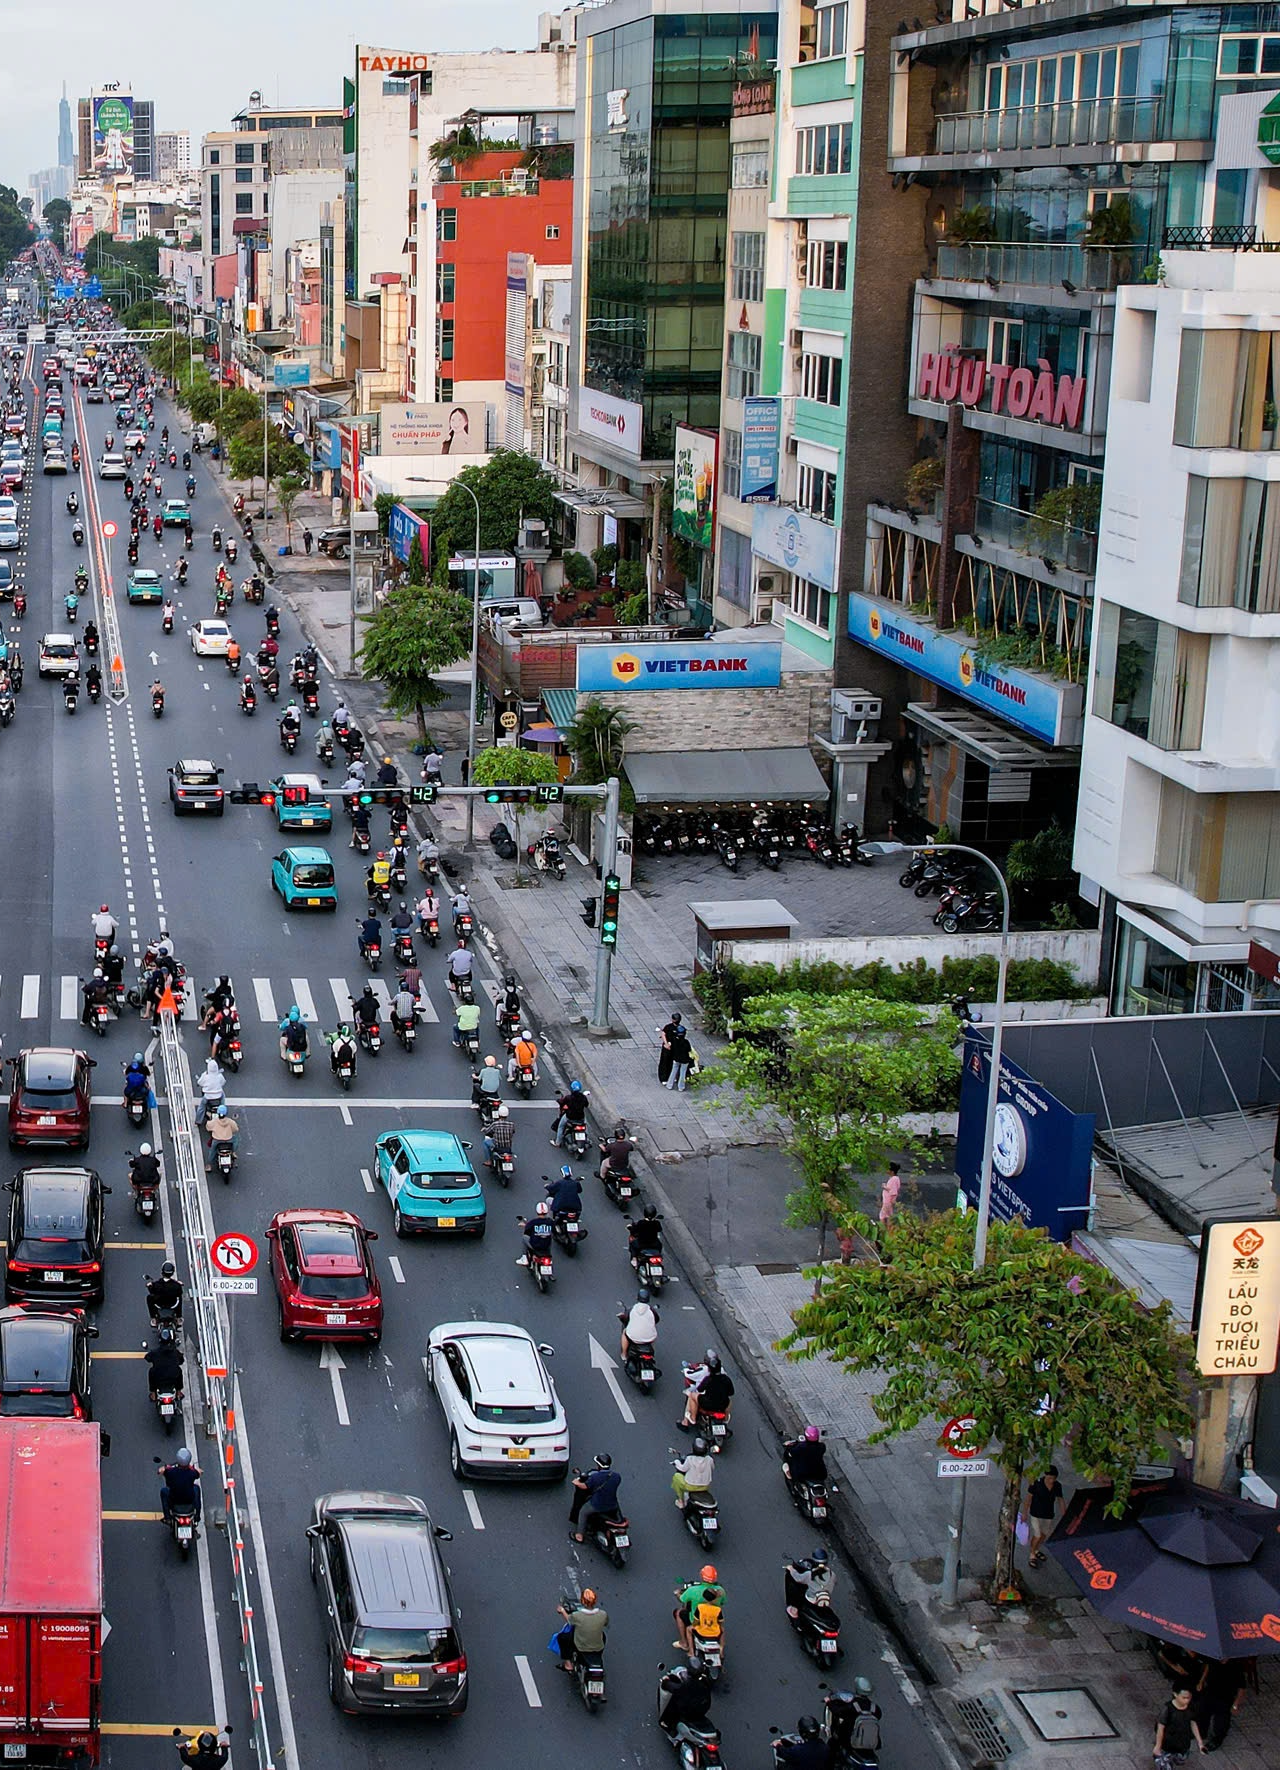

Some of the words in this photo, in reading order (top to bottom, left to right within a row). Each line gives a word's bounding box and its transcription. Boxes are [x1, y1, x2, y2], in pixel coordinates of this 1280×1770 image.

[359, 56, 427, 71] TAYHO
[920, 342, 986, 406] HỮU
[989, 358, 1087, 428] TOÀN
[881, 621, 925, 655] VIETBANK
[644, 658, 749, 673] VIETBANK
[974, 668, 1027, 706] VIETBANK
[414, 787, 433, 800] 42
[540, 786, 559, 800] 42
[1232, 1257, 1260, 1269] 天龙
[1228, 1281, 1259, 1299] LẨU
[1230, 1302, 1253, 1316] BÒ
[1215, 1333, 1260, 1351] TRIỀU
[1214, 1353, 1258, 1369] CHÂU
